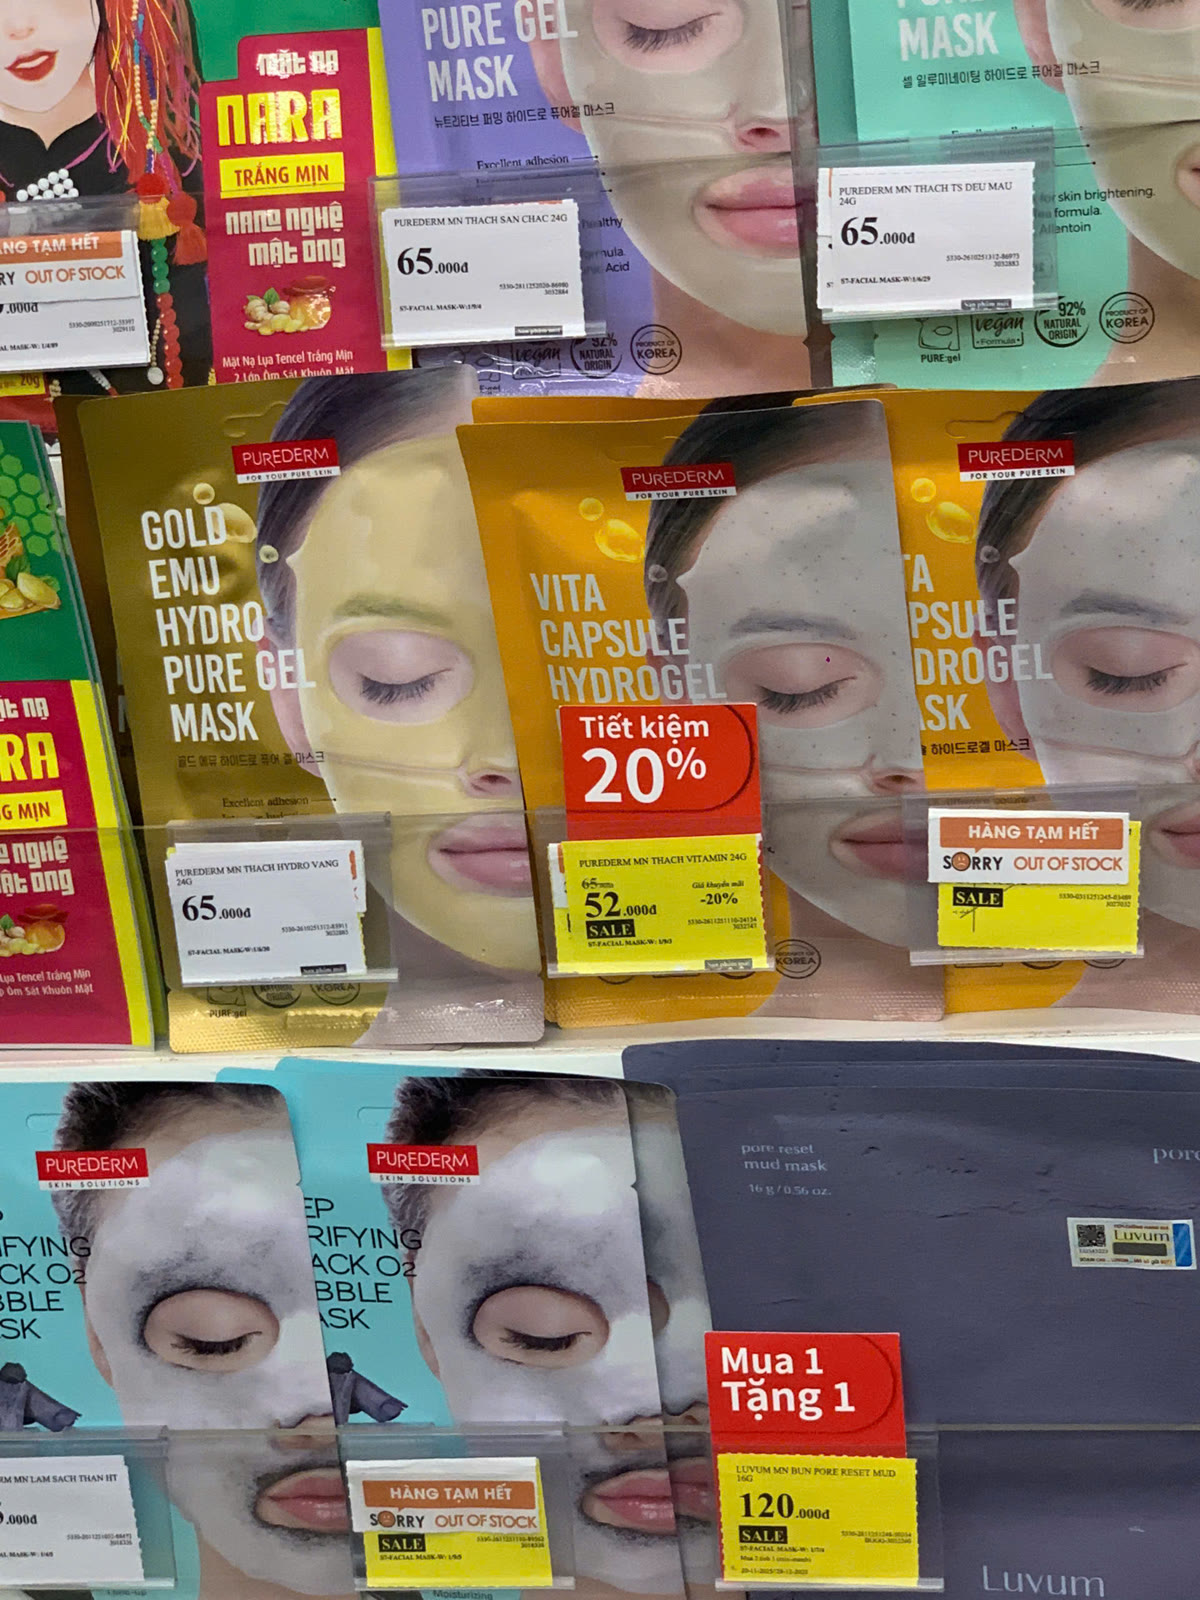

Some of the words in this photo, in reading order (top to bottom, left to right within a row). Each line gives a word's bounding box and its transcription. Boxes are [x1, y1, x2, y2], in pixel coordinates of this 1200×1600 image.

[422, 2, 506, 50] PURE
[514, 0, 578, 42] GEL
[898, 11, 999, 62] MASK
[428, 54, 518, 102] MASK
[916, 70, 981, 88] 일루미네이팅
[984, 66, 1027, 82] 하이드로
[1031, 64, 1063, 79] 퓨어겔
[1066, 60, 1100, 76] 마스크
[217, 89, 342, 146] NARA
[483, 112, 503, 125] 퍼밍
[506, 108, 546, 122] 하이드로
[550, 105, 580, 120] 퓨어겔
[583, 102, 615, 116] 마스크
[525, 154, 569, 167] adhesion
[234, 162, 289, 186] TRẮNG
[296, 164, 329, 186] MỊN
[839, 185, 893, 196] PUREDERM
[896, 185, 912, 194] MN
[914, 184, 948, 193] THACH
[951, 184, 963, 192] TS
[966, 183, 987, 192] DEU
[988, 182, 1013, 191] MAU
[1058, 190, 1081, 202] skin
[1084, 187, 1156, 201] brightening.
[839, 197, 857, 206] 24G
[1054, 205, 1102, 218] formula.
[394, 216, 446, 227] PUREDERM
[448, 216, 463, 225] MN
[465, 215, 498, 225] THACH
[500, 214, 520, 224] SAN
[522, 214, 549, 224] CHAC
[551, 213, 568, 222] 24G
[32, 239, 66, 256] TẠM
[72, 232, 100, 250] HẾT
[606, 261, 630, 272] Acid
[25, 269, 53, 284] OUT
[56, 268, 76, 282] OF
[78, 265, 126, 281] STOCK
[1058, 301, 1086, 317] 92%
[976, 317, 1023, 337] vegan
[1043, 317, 1081, 329] NATURAL
[1106, 317, 1149, 329] KOREA
[980, 338, 1016, 346] Formula
[1048, 329, 1078, 340] ORIGIN
[276, 351, 304, 364] Tencel
[307, 349, 333, 364] Trắng
[336, 350, 353, 362] Mịn
[580, 349, 615, 360] NATURAL
[637, 347, 677, 359] KOREA
[921, 354, 960, 364] PURE:gel
[584, 359, 612, 370] ORIGIN
[243, 448, 329, 468] PUREDERM
[968, 448, 1063, 466] PUREDERM
[632, 470, 724, 487] PUREDERM
[141, 505, 227, 550] GOLD
[148, 556, 220, 599] EMU
[530, 573, 606, 612] VITA
[156, 601, 264, 647] HYDRO
[540, 618, 690, 658] CAPSULE
[163, 653, 247, 695] PURE
[256, 648, 316, 691] GEL
[548, 663, 727, 704] HYDROGEL
[170, 700, 259, 742] MASK
[579, 713, 634, 738] Tiết
[641, 714, 709, 744] kiệm
[994, 738, 1030, 752] 마스크
[295, 751, 324, 764] 마스크
[582, 747, 706, 804] 20%
[222, 798, 264, 808] Excellent
[267, 795, 309, 806] adhesion
[18, 801, 50, 822] MỊN
[968, 820, 1020, 839] HÀNG
[1026, 827, 1062, 844] TẠM
[1069, 821, 1100, 840] HẾT
[175, 867, 224, 878] PUREDERM
[227, 865, 241, 874] MN
[243, 863, 275, 873] THACH
[278, 861, 310, 871] HYDRO
[312, 859, 339, 869] VANG
[580, 858, 631, 868] PUREDERM
[651, 856, 684, 865] THACH
[686, 854, 728, 863] VITAMIN
[1013, 856, 1043, 871] OUT
[1048, 856, 1068, 871] OF
[1072, 856, 1122, 872] STOCK
[700, 892, 738, 905] -20%
[956, 891, 1000, 905] SALE
[590, 924, 632, 937] SALE
[775, 957, 816, 965] KOREA
[17, 972, 44, 982] Tencel
[741, 1144, 774, 1154] pore
[780, 1144, 814, 1154] reset
[46, 1156, 138, 1176] PUREDERM
[377, 1150, 469, 1172] PUREDERM
[744, 1160, 780, 1170] mud
[785, 1160, 828, 1171] mask
[80, 1180, 140, 1188] SOLUTIONS
[1114, 1229, 1170, 1242] Luvum
[721, 1346, 794, 1375] Mua
[805, 1348, 823, 1375] 1
[721, 1377, 823, 1421] Tặng
[834, 1382, 855, 1412] 1
[79, 1474, 104, 1482] THAN
[736, 1465, 771, 1475] LUVUM
[773, 1466, 788, 1475] MN
[790, 1466, 812, 1475] BUN
[814, 1467, 838, 1476] PORE
[840, 1467, 870, 1476] RESET
[873, 1468, 896, 1477] MUD
[390, 1484, 439, 1500] HÀNG
[444, 1487, 479, 1504] TẠM
[484, 1483, 512, 1500] HẾT
[435, 1514, 464, 1528] OUT
[466, 1514, 487, 1528] OF
[490, 1514, 538, 1529] STOCK
[742, 1529, 784, 1542] SALE
[382, 1538, 423, 1550] SALE
[982, 1565, 1105, 1597] Luvum
[432, 1590, 493, 1600] Moisturizing
